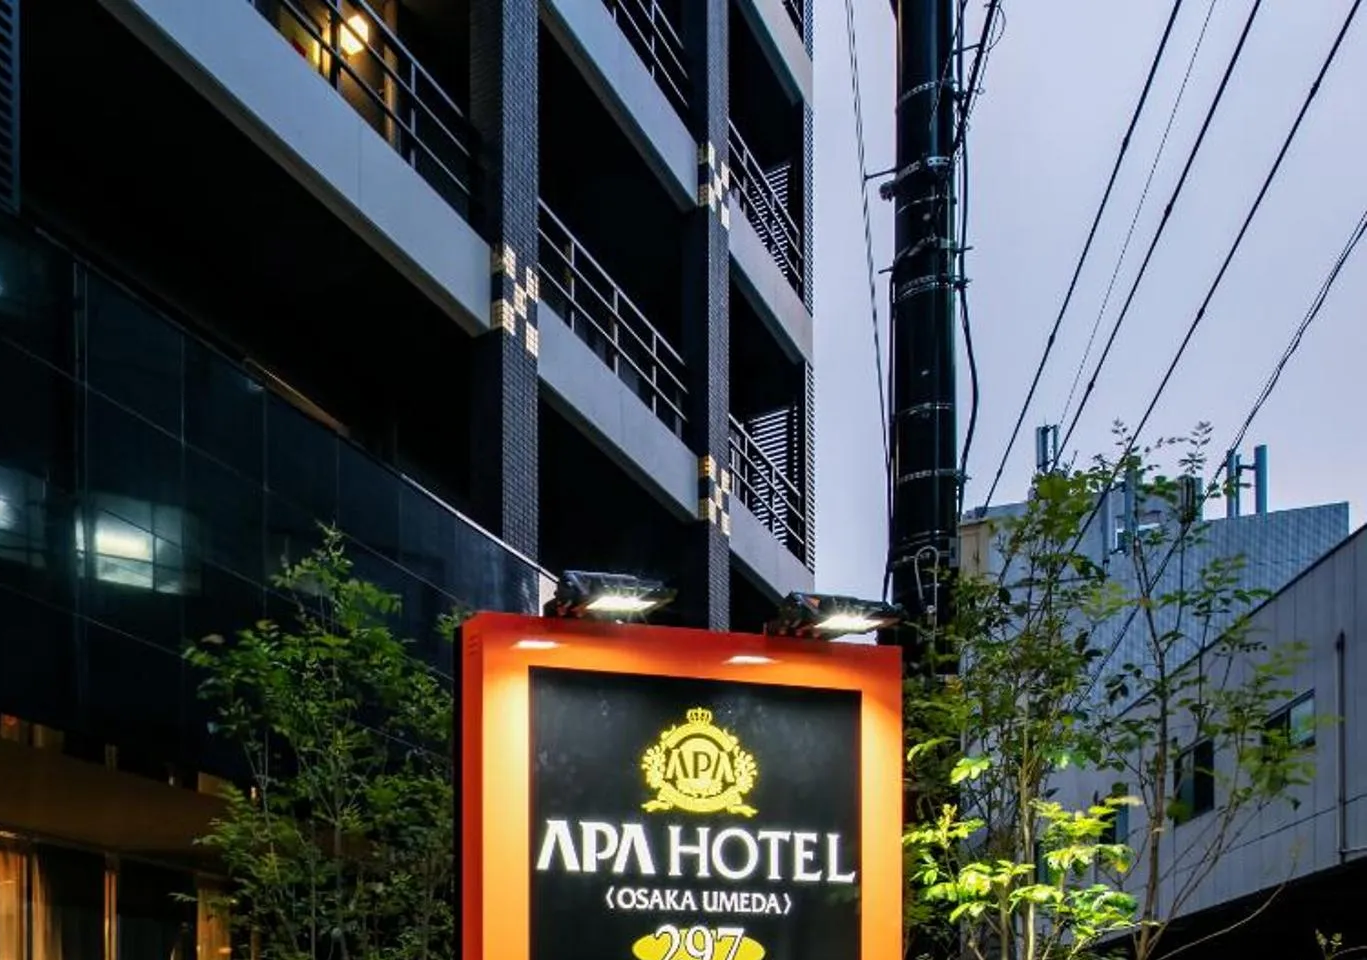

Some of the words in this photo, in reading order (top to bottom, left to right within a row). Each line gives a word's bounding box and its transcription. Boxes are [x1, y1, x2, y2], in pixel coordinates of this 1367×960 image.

[663, 748, 736, 784] APA
[537, 819, 653, 874] APA
[669, 825, 856, 883] HOTEL
